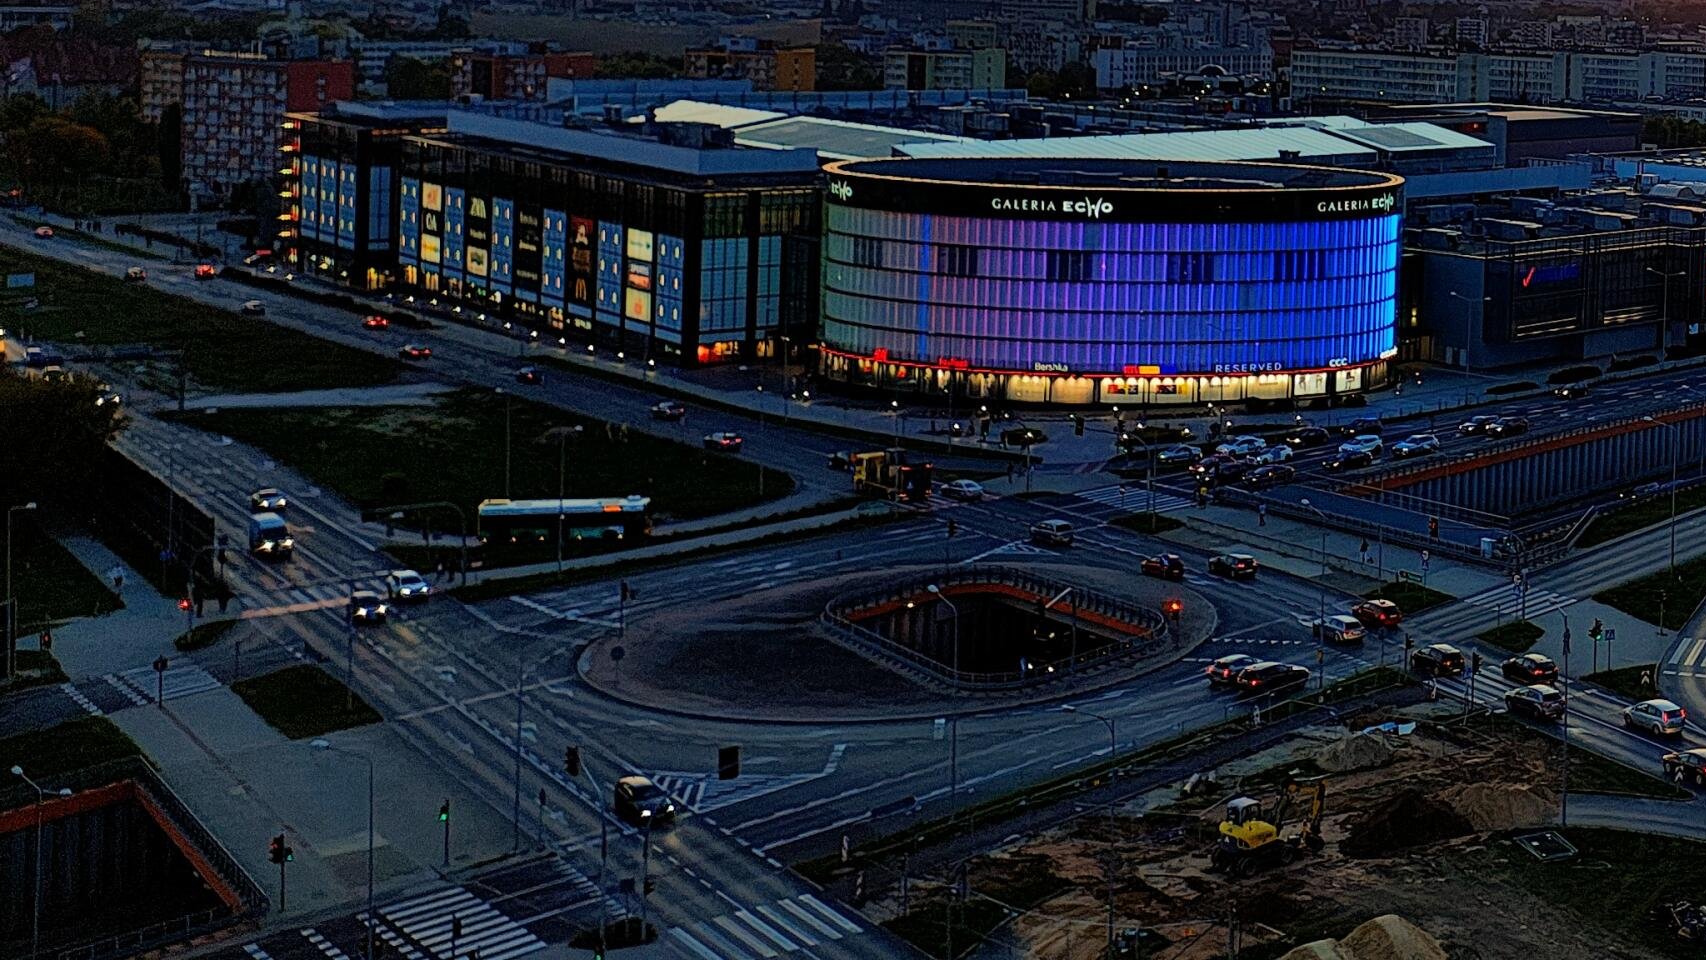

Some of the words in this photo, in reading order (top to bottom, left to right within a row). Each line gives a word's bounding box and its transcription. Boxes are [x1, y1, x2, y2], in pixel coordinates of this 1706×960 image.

[991, 198, 1056, 211] GALERIA
[1062, 196, 1114, 219] ECHO
[1317, 200, 1369, 212] GALERIA
[1371, 192, 1394, 212] ECHO
[1034, 362, 1069, 372] Bershka
[1215, 362, 1282, 373] RESERVED
[1329, 357, 1348, 368] CCC
